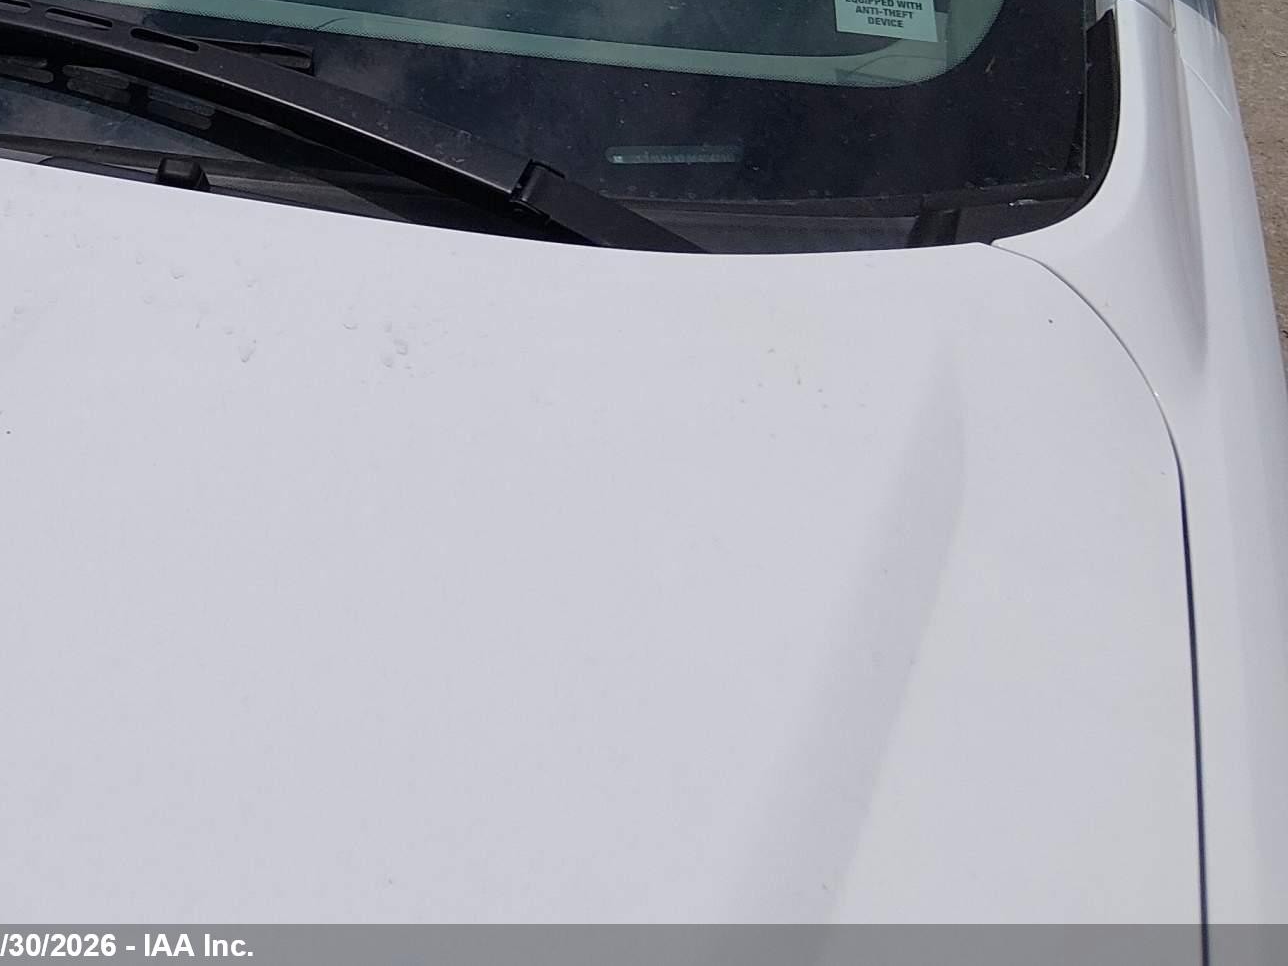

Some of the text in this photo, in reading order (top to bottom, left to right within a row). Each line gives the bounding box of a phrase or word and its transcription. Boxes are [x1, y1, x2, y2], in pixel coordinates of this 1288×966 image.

[897, 0, 922, 10] WITH
[855, 6, 914, 19] ANTI-THEFT
[867, 17, 904, 28] DEVICE
